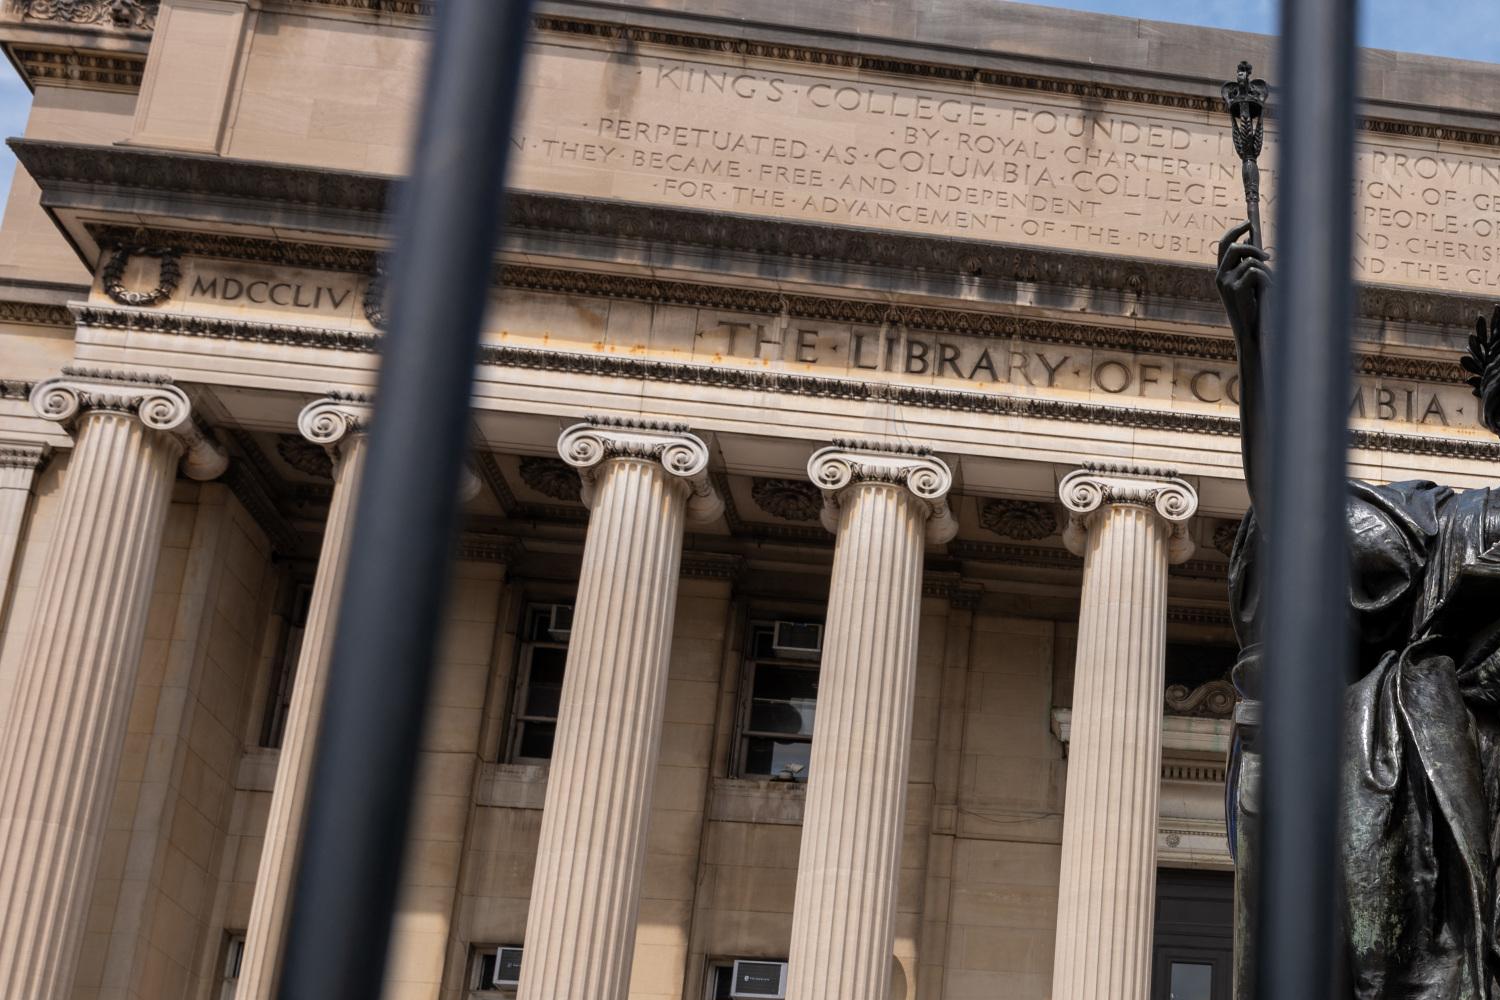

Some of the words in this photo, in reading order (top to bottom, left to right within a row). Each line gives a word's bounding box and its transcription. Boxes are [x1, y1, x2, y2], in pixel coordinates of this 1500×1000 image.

[806, 83, 986, 126] COLLEGE
[1011, 107, 1191, 150] FOUNDED
[542, 139, 617, 163] THEY
[631, 150, 741, 178] BECAME
[759, 164, 824, 187] FREE
[839, 175, 897, 195] AND
[914, 182, 1102, 218] INDEPENDENT
[598, 117, 808, 160] PERPETUATED
[822, 144, 858, 166] AS
[874, 147, 1057, 188] COLUMBIA
[1071, 170, 1229, 207] COLLEGE
[1363, 205, 1458, 234] PEOPLE
[904, 126, 940, 146] BY
[957, 132, 1047, 160] ROYAL
[1064, 145, 1192, 177] CHARTER
[1209, 162, 1236, 181] IN
[1421, 187, 1457, 207] OF
[663, 178, 717, 202] FOR
[732, 185, 785, 208] THE
[801, 195, 1007, 233] ADVANCEMENT
[1020, 218, 1056, 238] OF
[1070, 223, 1121, 246] THE
[1400, 260, 1449, 282] THE
[189, 274, 351, 310] MDCCLIV
[717, 320, 819, 363] THE
[852, 333, 1072, 388] LIBRARY
[1093, 360, 1165, 398] OF
